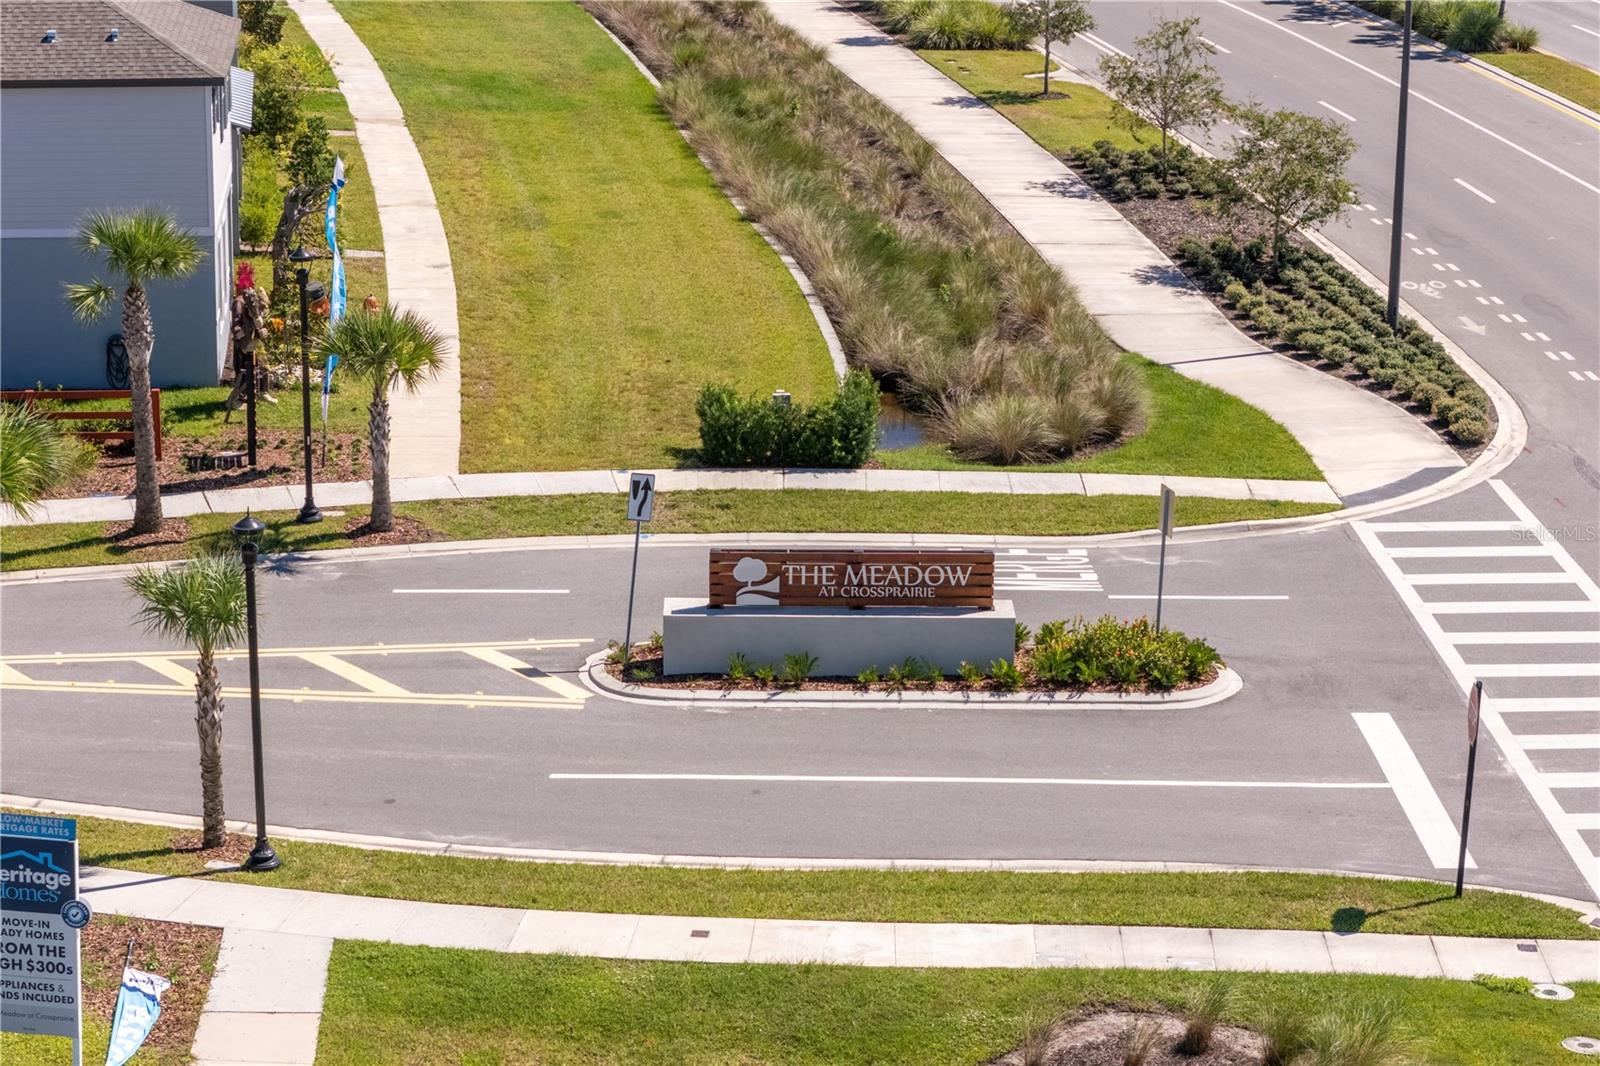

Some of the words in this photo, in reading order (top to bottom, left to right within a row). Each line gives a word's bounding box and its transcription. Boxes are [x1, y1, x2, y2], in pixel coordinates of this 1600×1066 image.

[781, 565, 837, 586] THE
[844, 565, 972, 586] MEADOW
[818, 586, 836, 598] AT
[840, 586, 936, 598] CROSSPRAIRIE
[41, 827, 70, 836] RATES
[0, 864, 71, 890] eritage
[2, 917, 50, 929] MOVE-IN
[1, 928, 22, 938] ADY
[25, 930, 65, 941] HOMES
[37, 944, 66, 958] THE
[0, 957, 22, 971] GH
[26, 958, 73, 975] $300s
[57, 984, 65, 993] &
[22, 992, 75, 1004] INCLUDED
